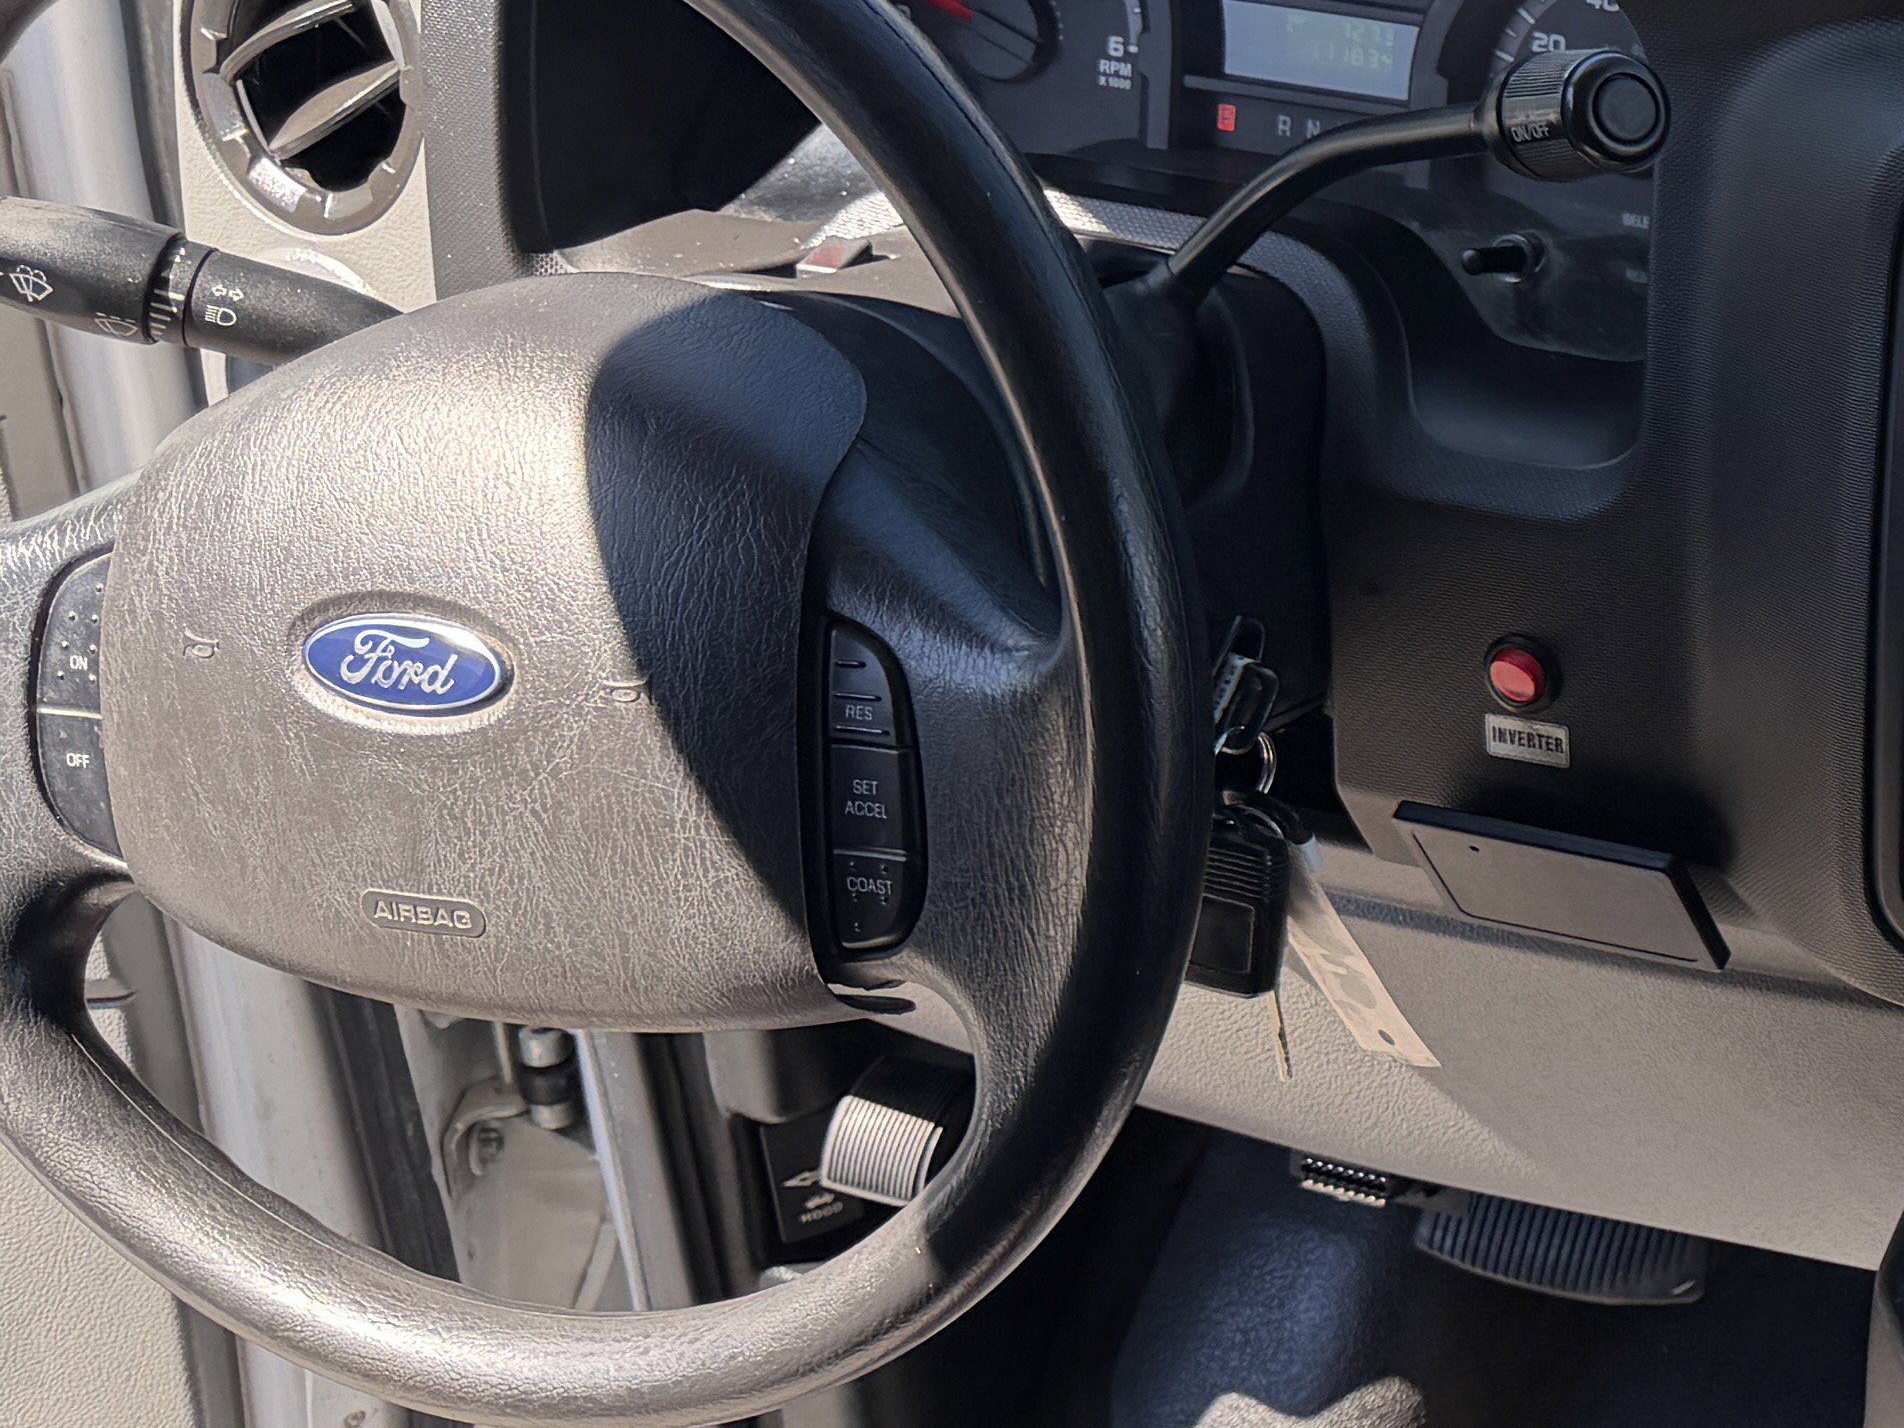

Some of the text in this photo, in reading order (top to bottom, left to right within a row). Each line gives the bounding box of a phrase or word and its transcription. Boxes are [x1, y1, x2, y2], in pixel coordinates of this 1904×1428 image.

[1107, 36, 1124, 57] 6
[1532, 32, 1567, 53] 20
[1099, 58, 1133, 78] RPM
[1278, 115, 1292, 138] R
[1510, 123, 1550, 143] ON/OFF
[69, 653, 89, 674] ON
[339, 627, 459, 697] Ford
[845, 705, 874, 722] RES
[1491, 725, 1566, 756] INVERTER
[65, 751, 91, 768] OFF
[852, 779, 880, 797] SET
[845, 801, 888, 821] ACCEL
[847, 876, 893, 896] COAST
[373, 899, 474, 932] AIRBAG
